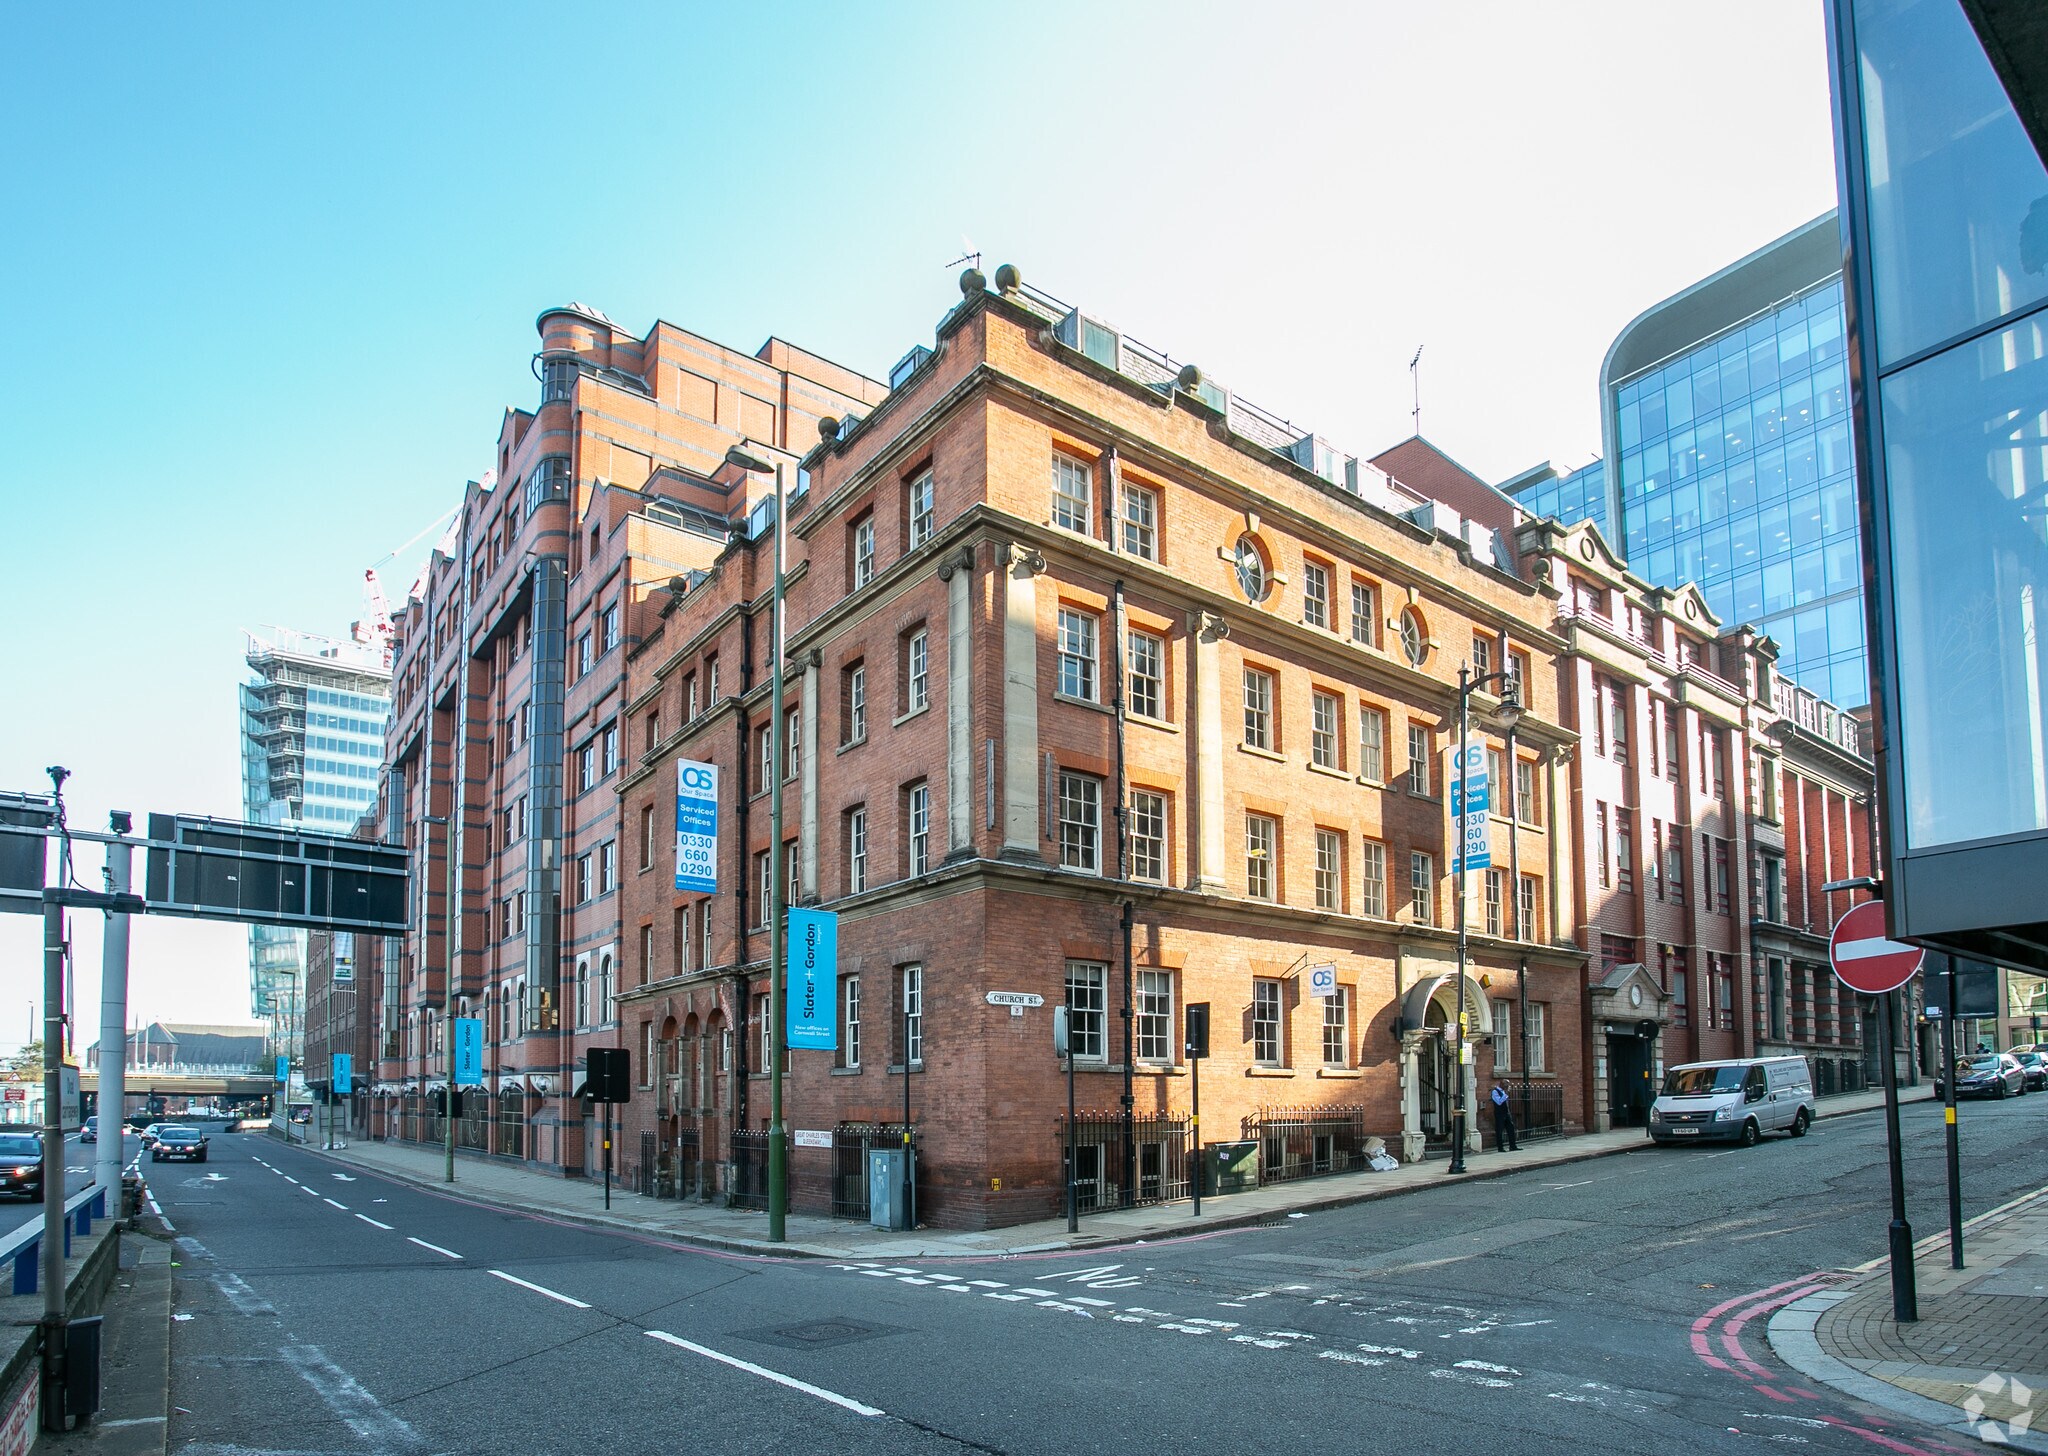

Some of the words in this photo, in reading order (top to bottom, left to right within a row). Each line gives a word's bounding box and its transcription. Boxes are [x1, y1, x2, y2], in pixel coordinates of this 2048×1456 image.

[682, 767, 713, 790] OS
[694, 790, 714, 798] Space
[680, 803, 715, 816] Serviced
[683, 815, 712, 827] Offices
[681, 834, 713, 849] 0330
[684, 848, 709, 862] 660
[680, 862, 712, 877] 0290
[1313, 970, 1332, 987] OS
[993, 994, 1025, 1004] CHURCH
